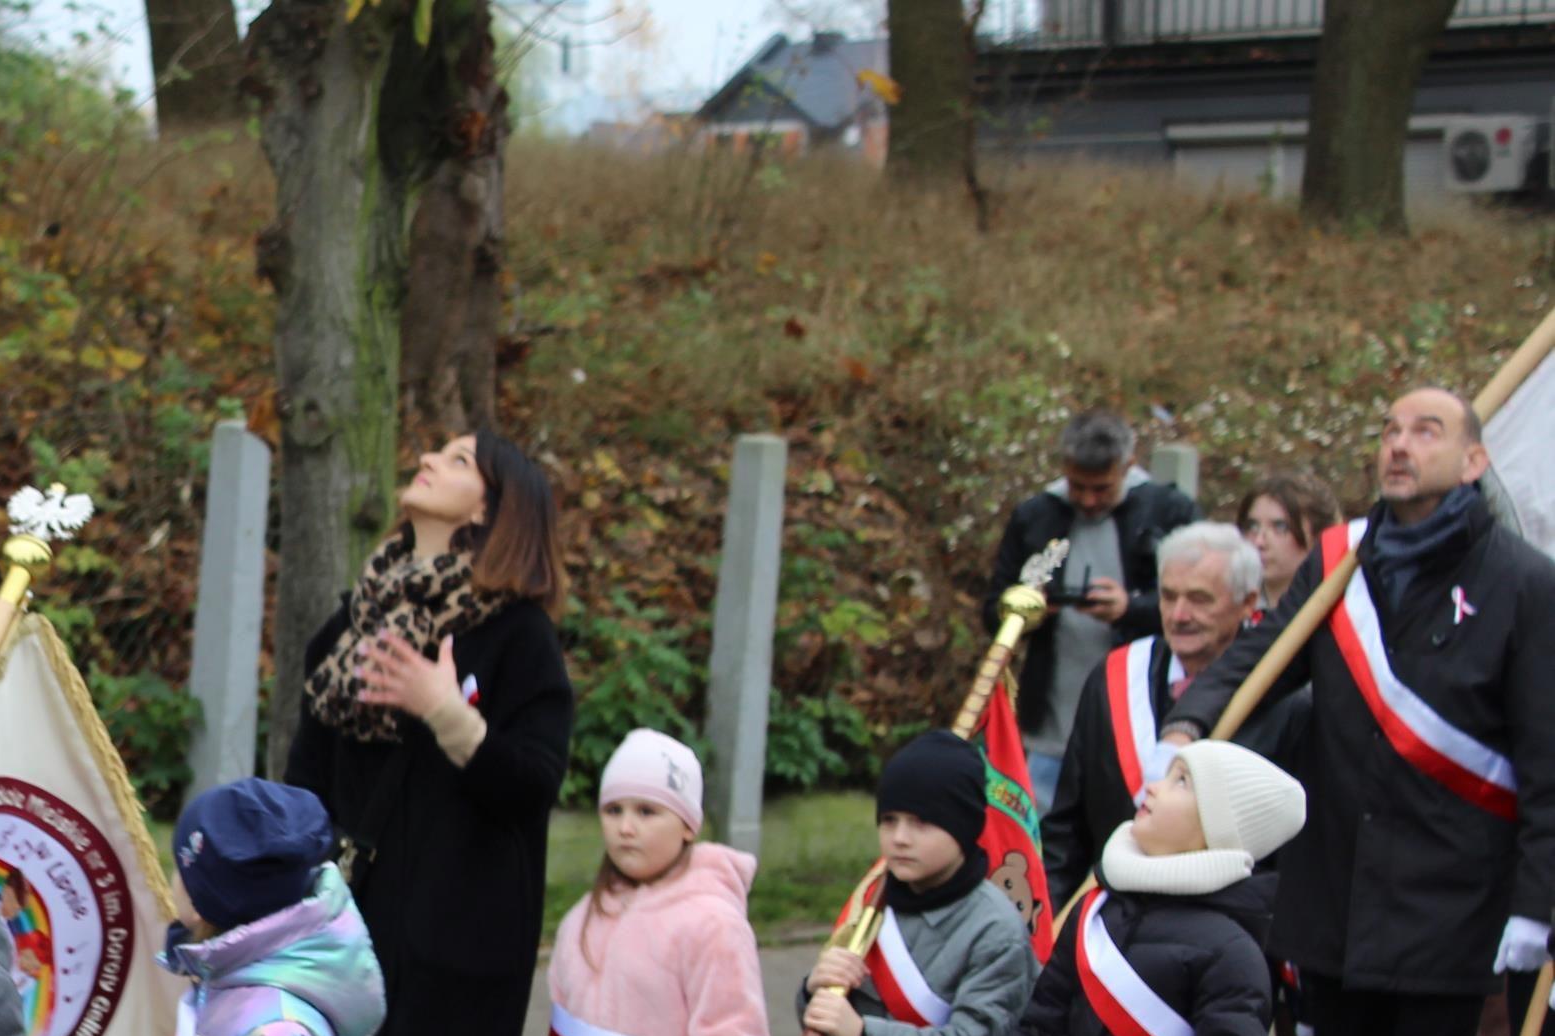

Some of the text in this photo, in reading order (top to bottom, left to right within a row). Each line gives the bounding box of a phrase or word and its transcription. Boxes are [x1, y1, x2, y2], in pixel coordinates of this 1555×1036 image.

[96, 872, 115, 887] 3
[103, 891, 123, 922] im.
[99, 927, 128, 992] Doroty
